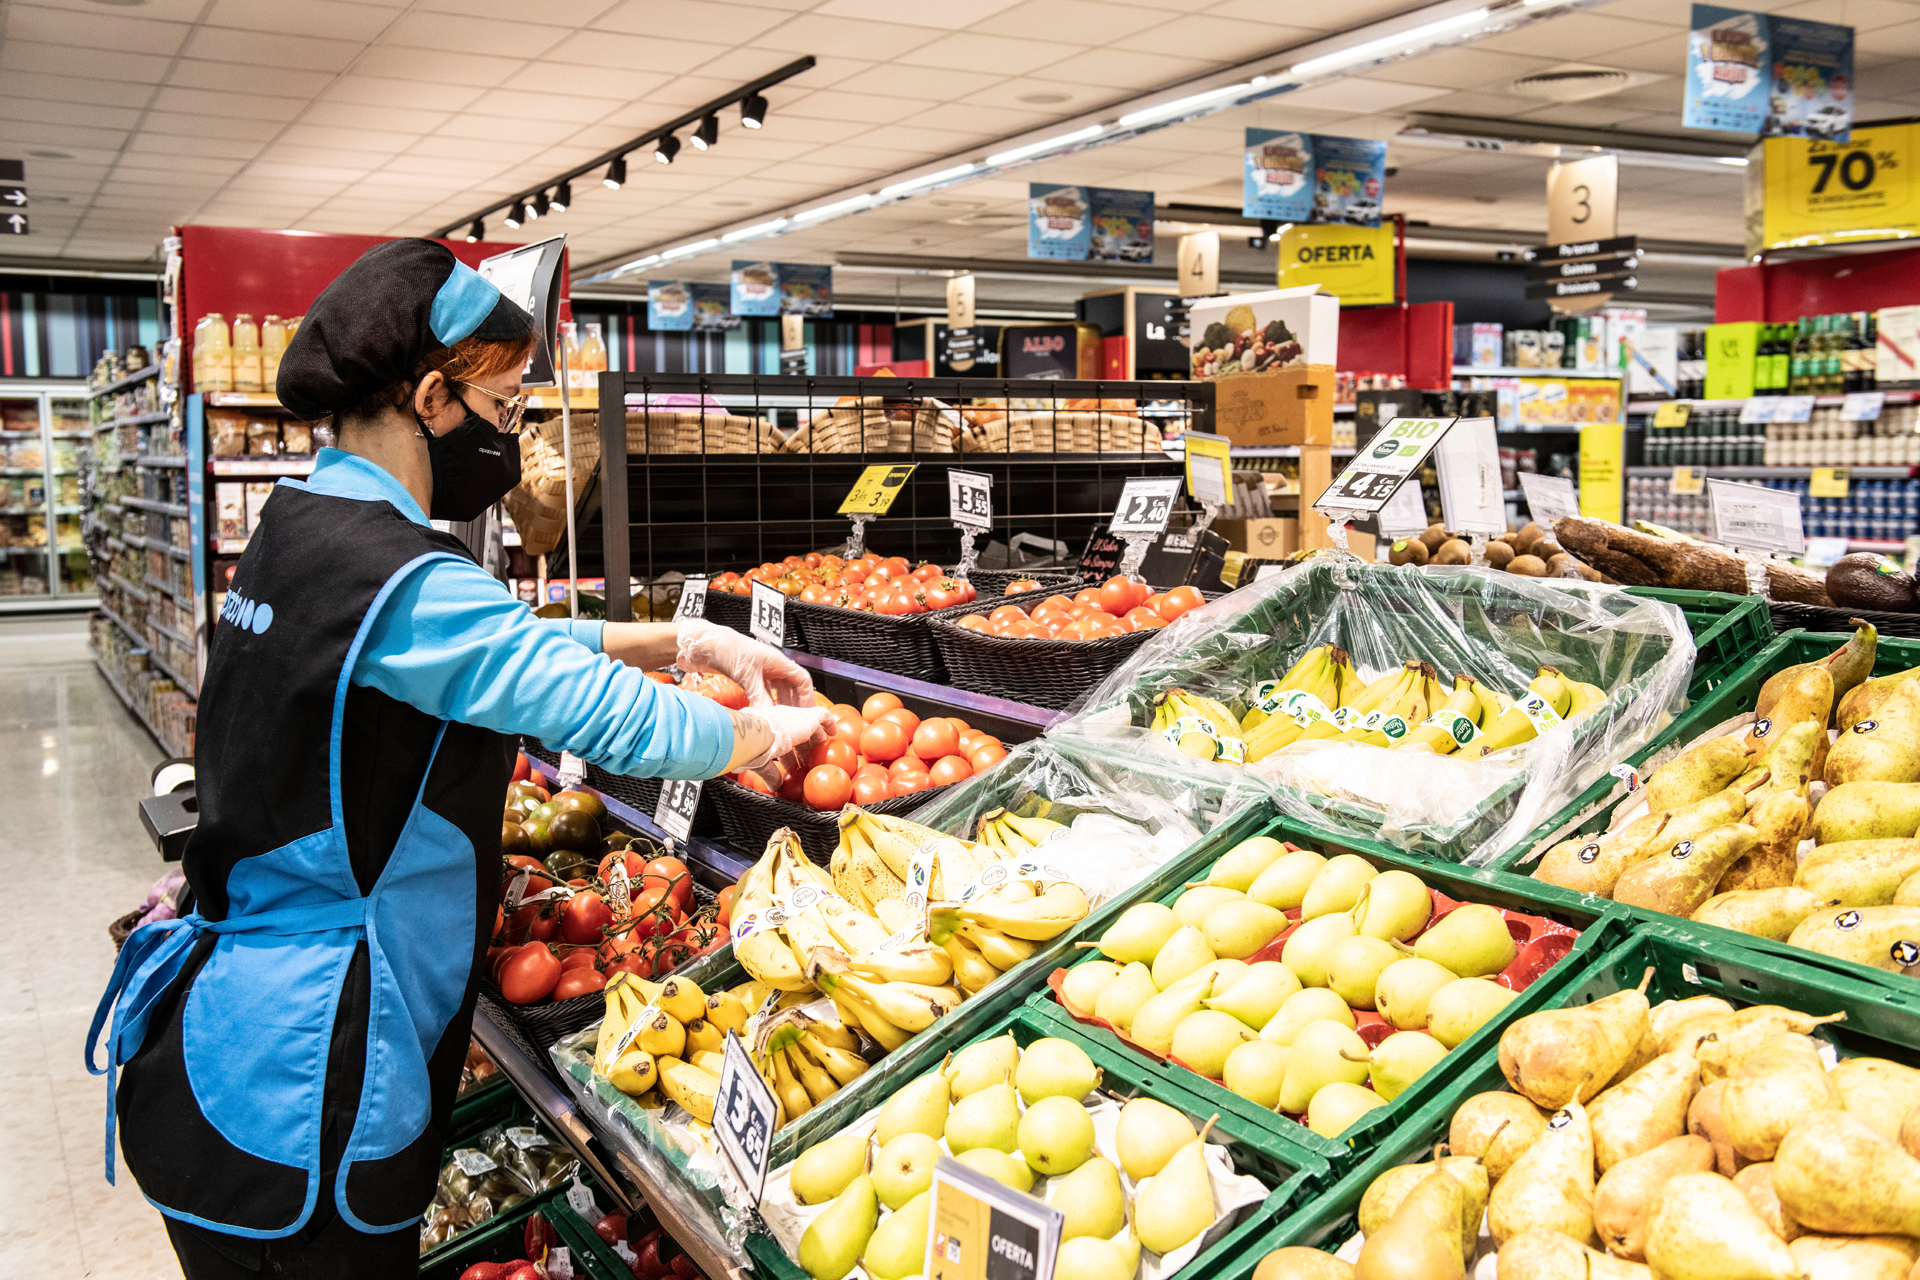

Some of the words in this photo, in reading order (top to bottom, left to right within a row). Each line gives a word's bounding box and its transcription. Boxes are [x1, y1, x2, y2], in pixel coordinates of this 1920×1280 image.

[1571, 185, 1592, 224] 3
[1297, 244, 1374, 263] OFERTA
[1023, 335, 1065, 352] ALBO
[1389, 420, 1440, 439] BIO
[962, 486, 987, 515] 3,55
[1129, 496, 1167, 524] 2,40
[730, 1079, 763, 1165] 3,65
[991, 1234, 1034, 1271] OFERTA
